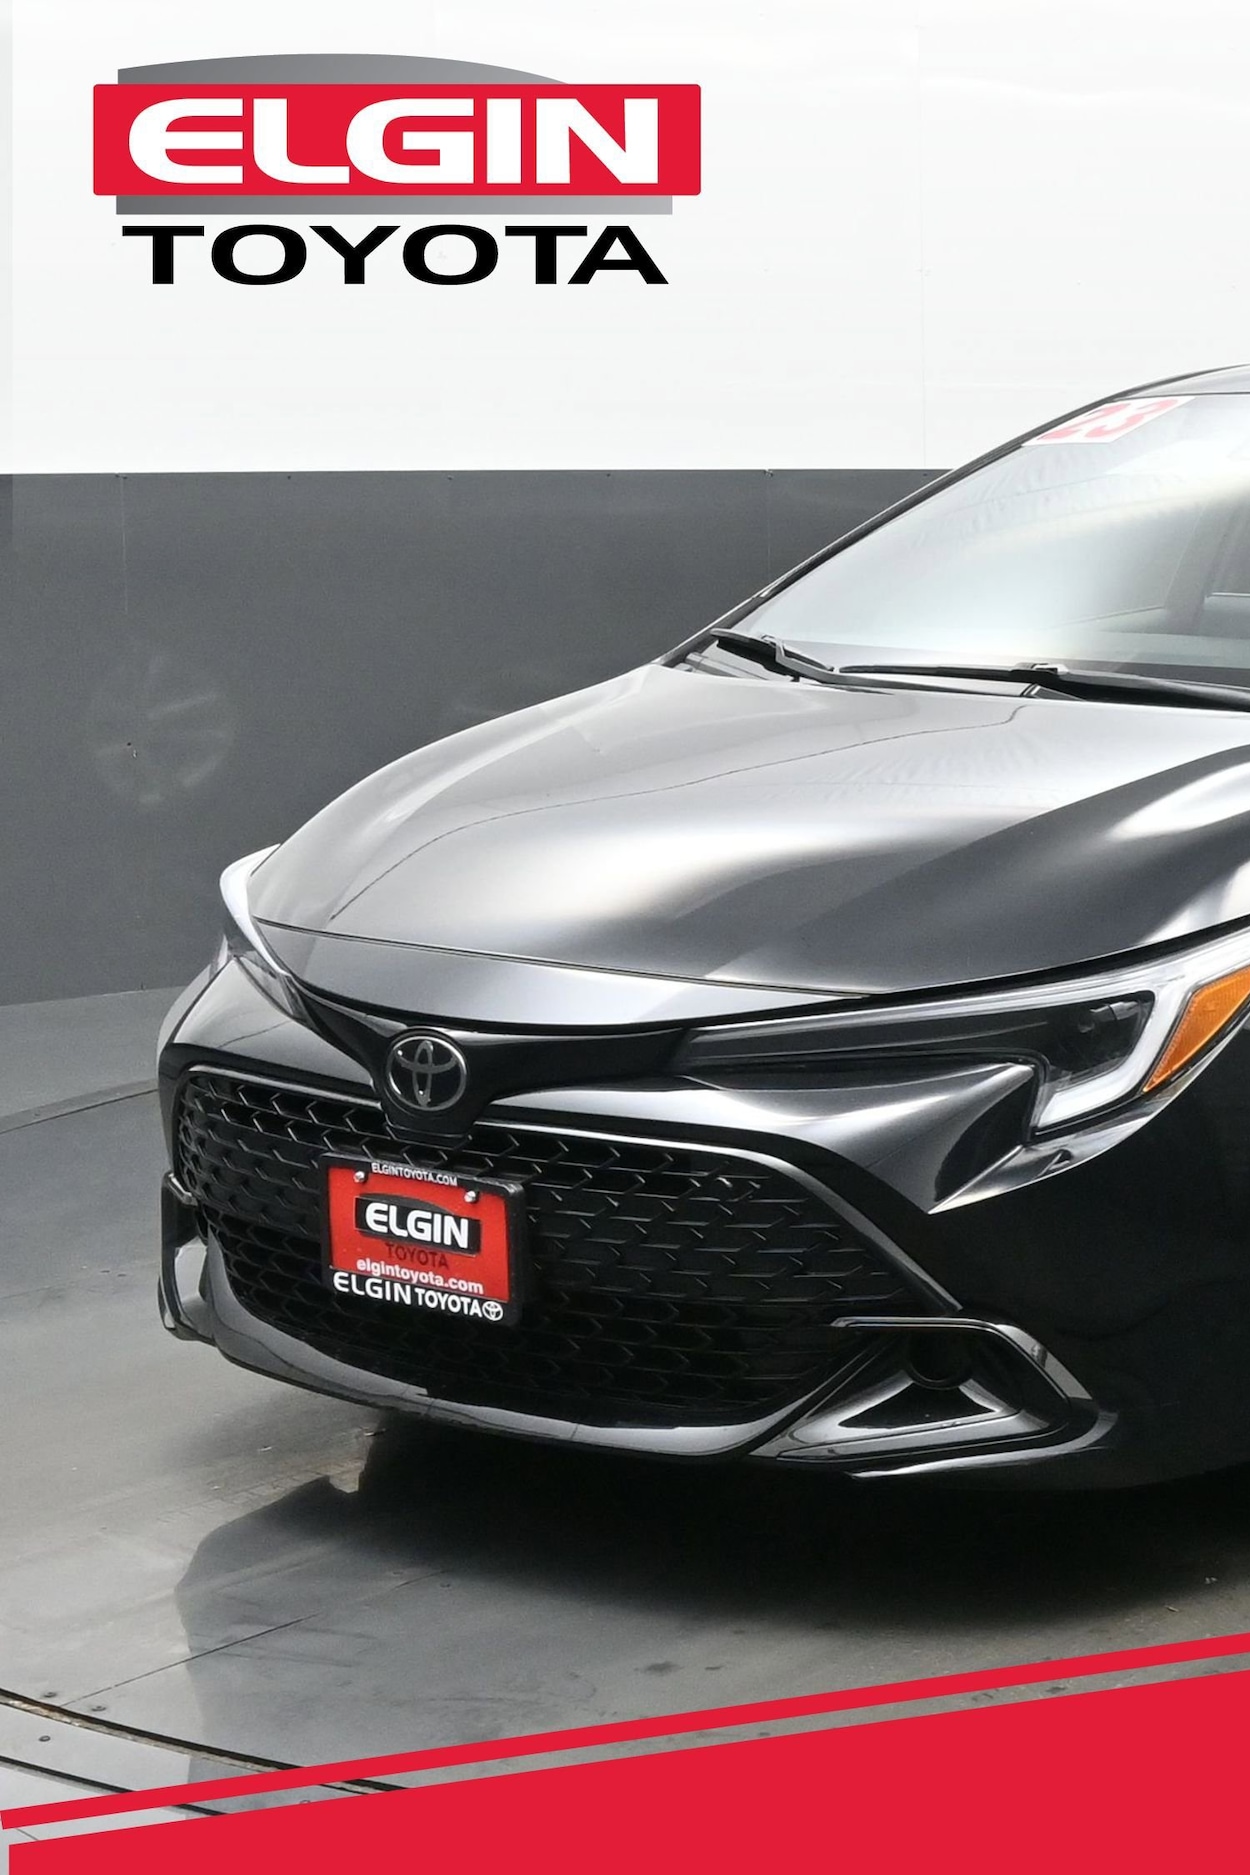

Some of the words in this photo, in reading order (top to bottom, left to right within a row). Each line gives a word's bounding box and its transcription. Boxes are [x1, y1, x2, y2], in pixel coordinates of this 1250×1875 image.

[1036, 399, 1179, 441] 23
[371, 1162, 458, 1187] ELGINTOYOTA.COM
[365, 1202, 469, 1248] ELGIN
[385, 1243, 449, 1269] TOYOTA
[333, 1271, 411, 1305] ELGIN
[414, 1287, 482, 1317] TOYOTA
[356, 1258, 484, 1294] elgintoyota.com
